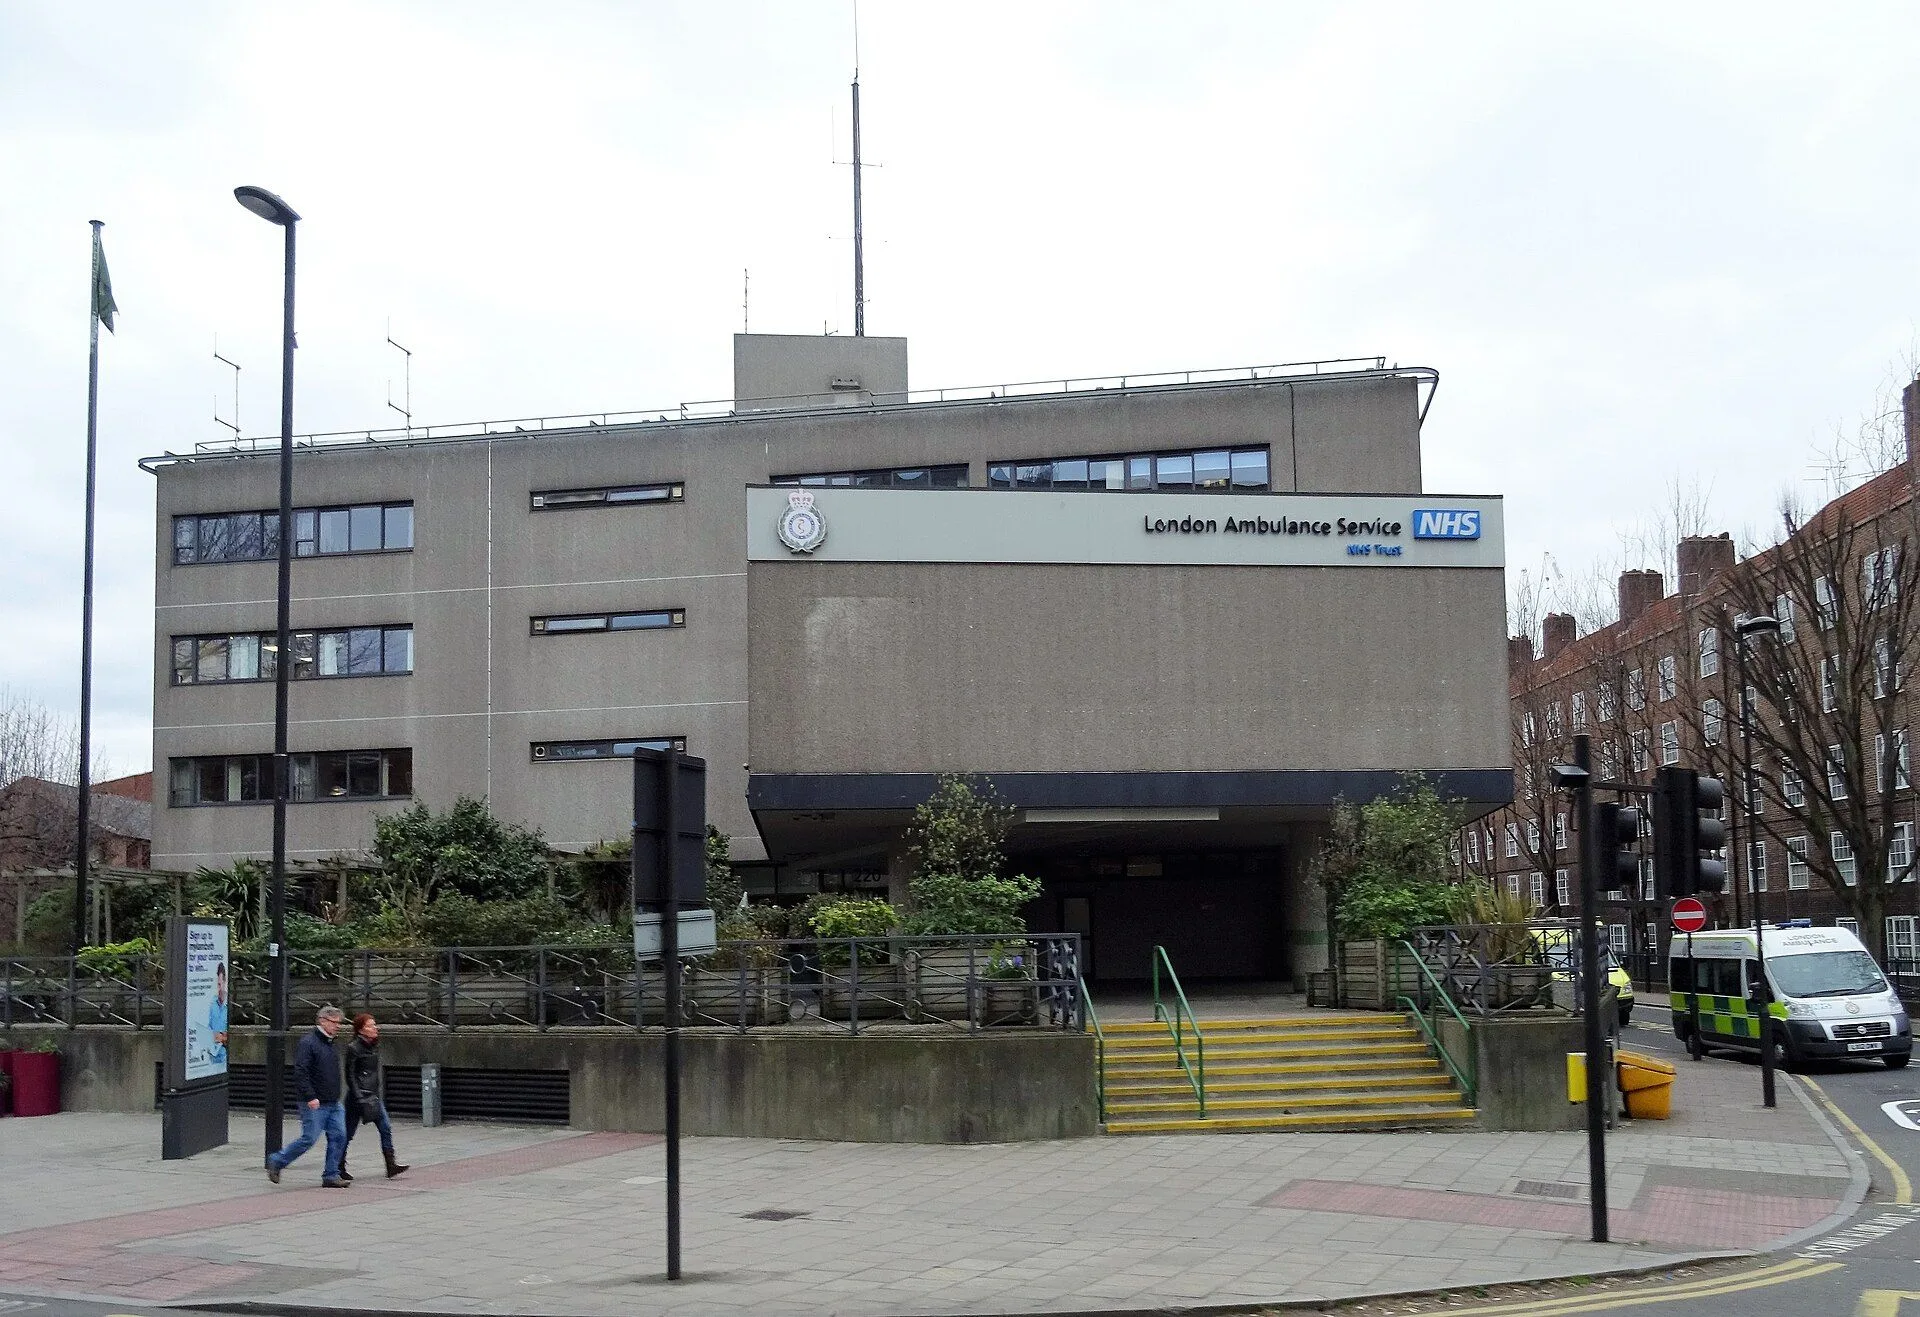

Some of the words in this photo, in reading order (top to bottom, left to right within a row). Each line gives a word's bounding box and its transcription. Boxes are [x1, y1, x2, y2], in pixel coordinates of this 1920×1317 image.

[1145, 514, 1217, 534] London
[1223, 515, 1331, 535] Ambulance
[1337, 517, 1402, 535] Service
[1419, 512, 1478, 535] NHS
[1347, 543, 1371, 556] NHS
[1374, 543, 1402, 557] Trust
[853, 869, 881, 882] 220
[1783, 938, 1838, 946] AMBULANCE
[1786, 933, 1826, 941] LONDON
